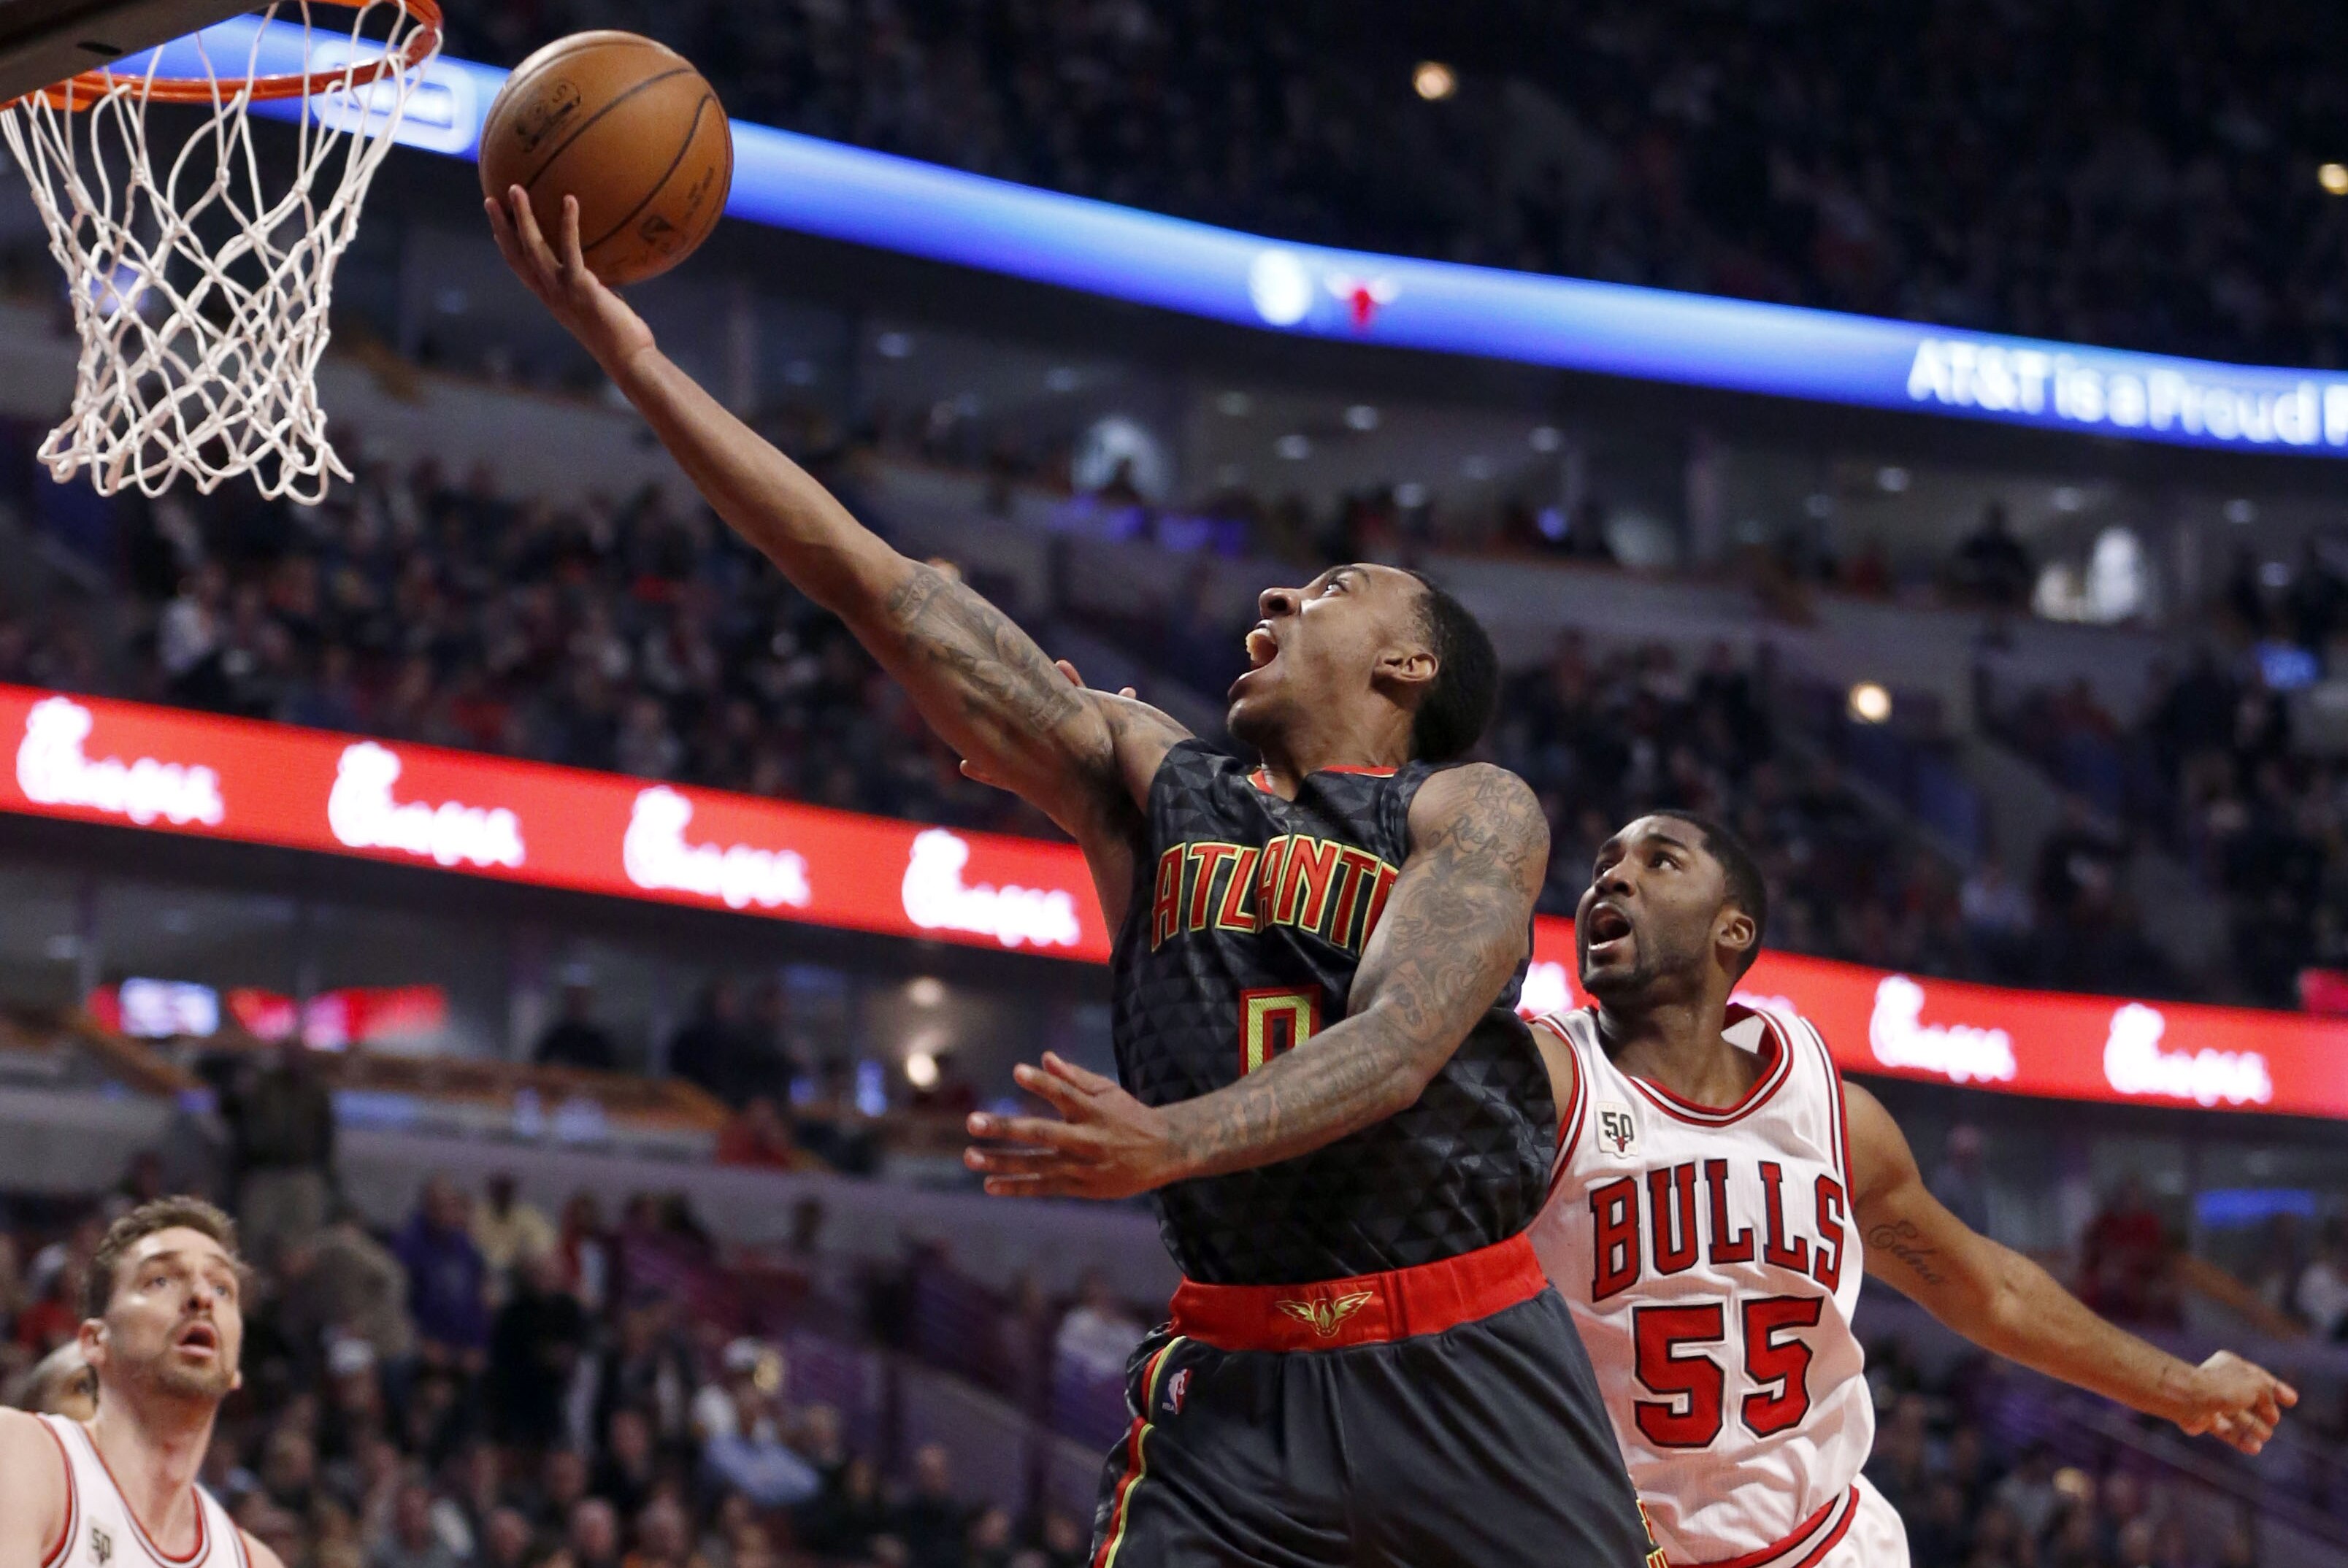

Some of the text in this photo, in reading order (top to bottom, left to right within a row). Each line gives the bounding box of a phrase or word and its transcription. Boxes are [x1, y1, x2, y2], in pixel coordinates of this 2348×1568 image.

[1908, 340, 2050, 415] AT&T
[2054, 355, 2106, 423] is
[2107, 373, 2147, 426] a
[2147, 369, 2320, 445] Proud
[1602, 1111, 1635, 1142] 50
[1589, 1158, 1845, 1302] BULLS
[1632, 1295, 1825, 1448] 55
